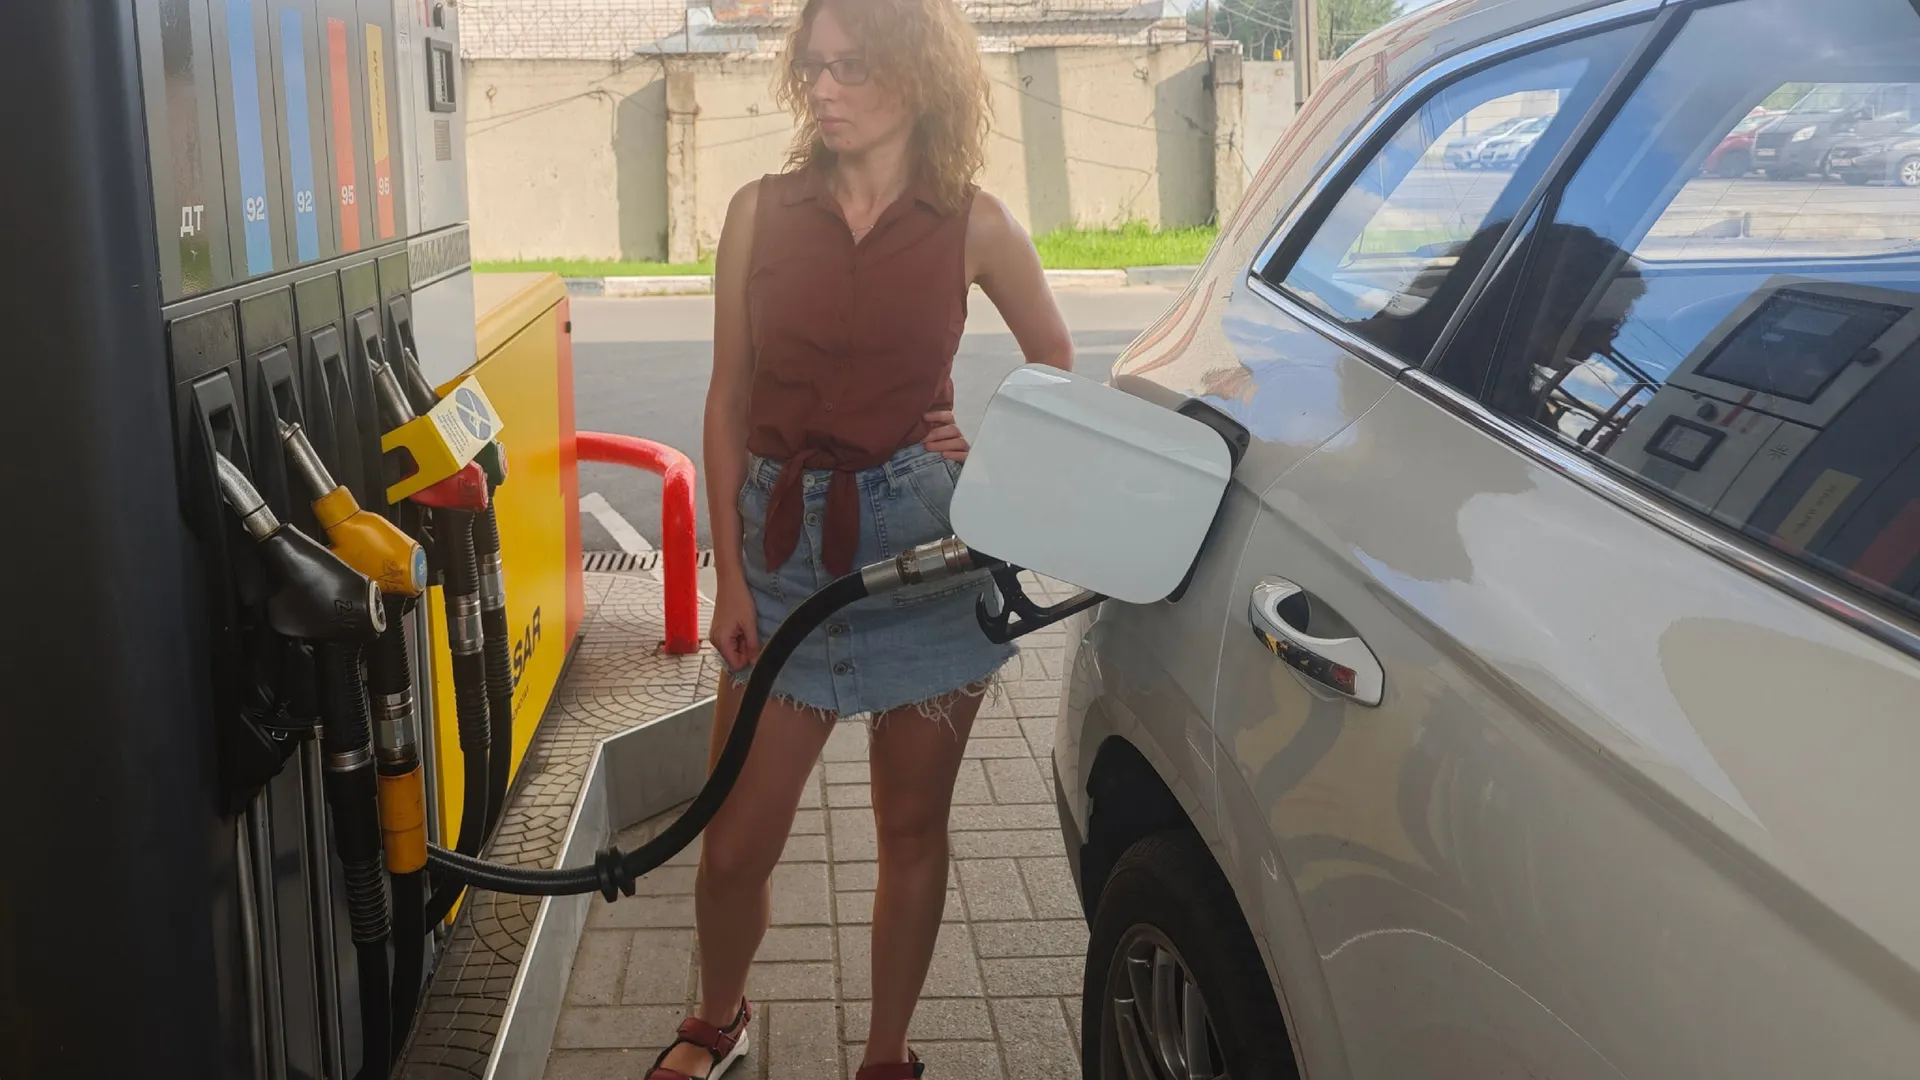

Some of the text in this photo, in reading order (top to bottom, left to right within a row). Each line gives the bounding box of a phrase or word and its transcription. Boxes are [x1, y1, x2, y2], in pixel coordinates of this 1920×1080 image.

[341, 185, 355, 206] 95
[379, 177, 390, 196] 95
[246, 196, 265, 222] 92
[297, 190, 313, 213] 92
[180, 204, 204, 238] ДТ
[513, 605, 541, 688] SAR
